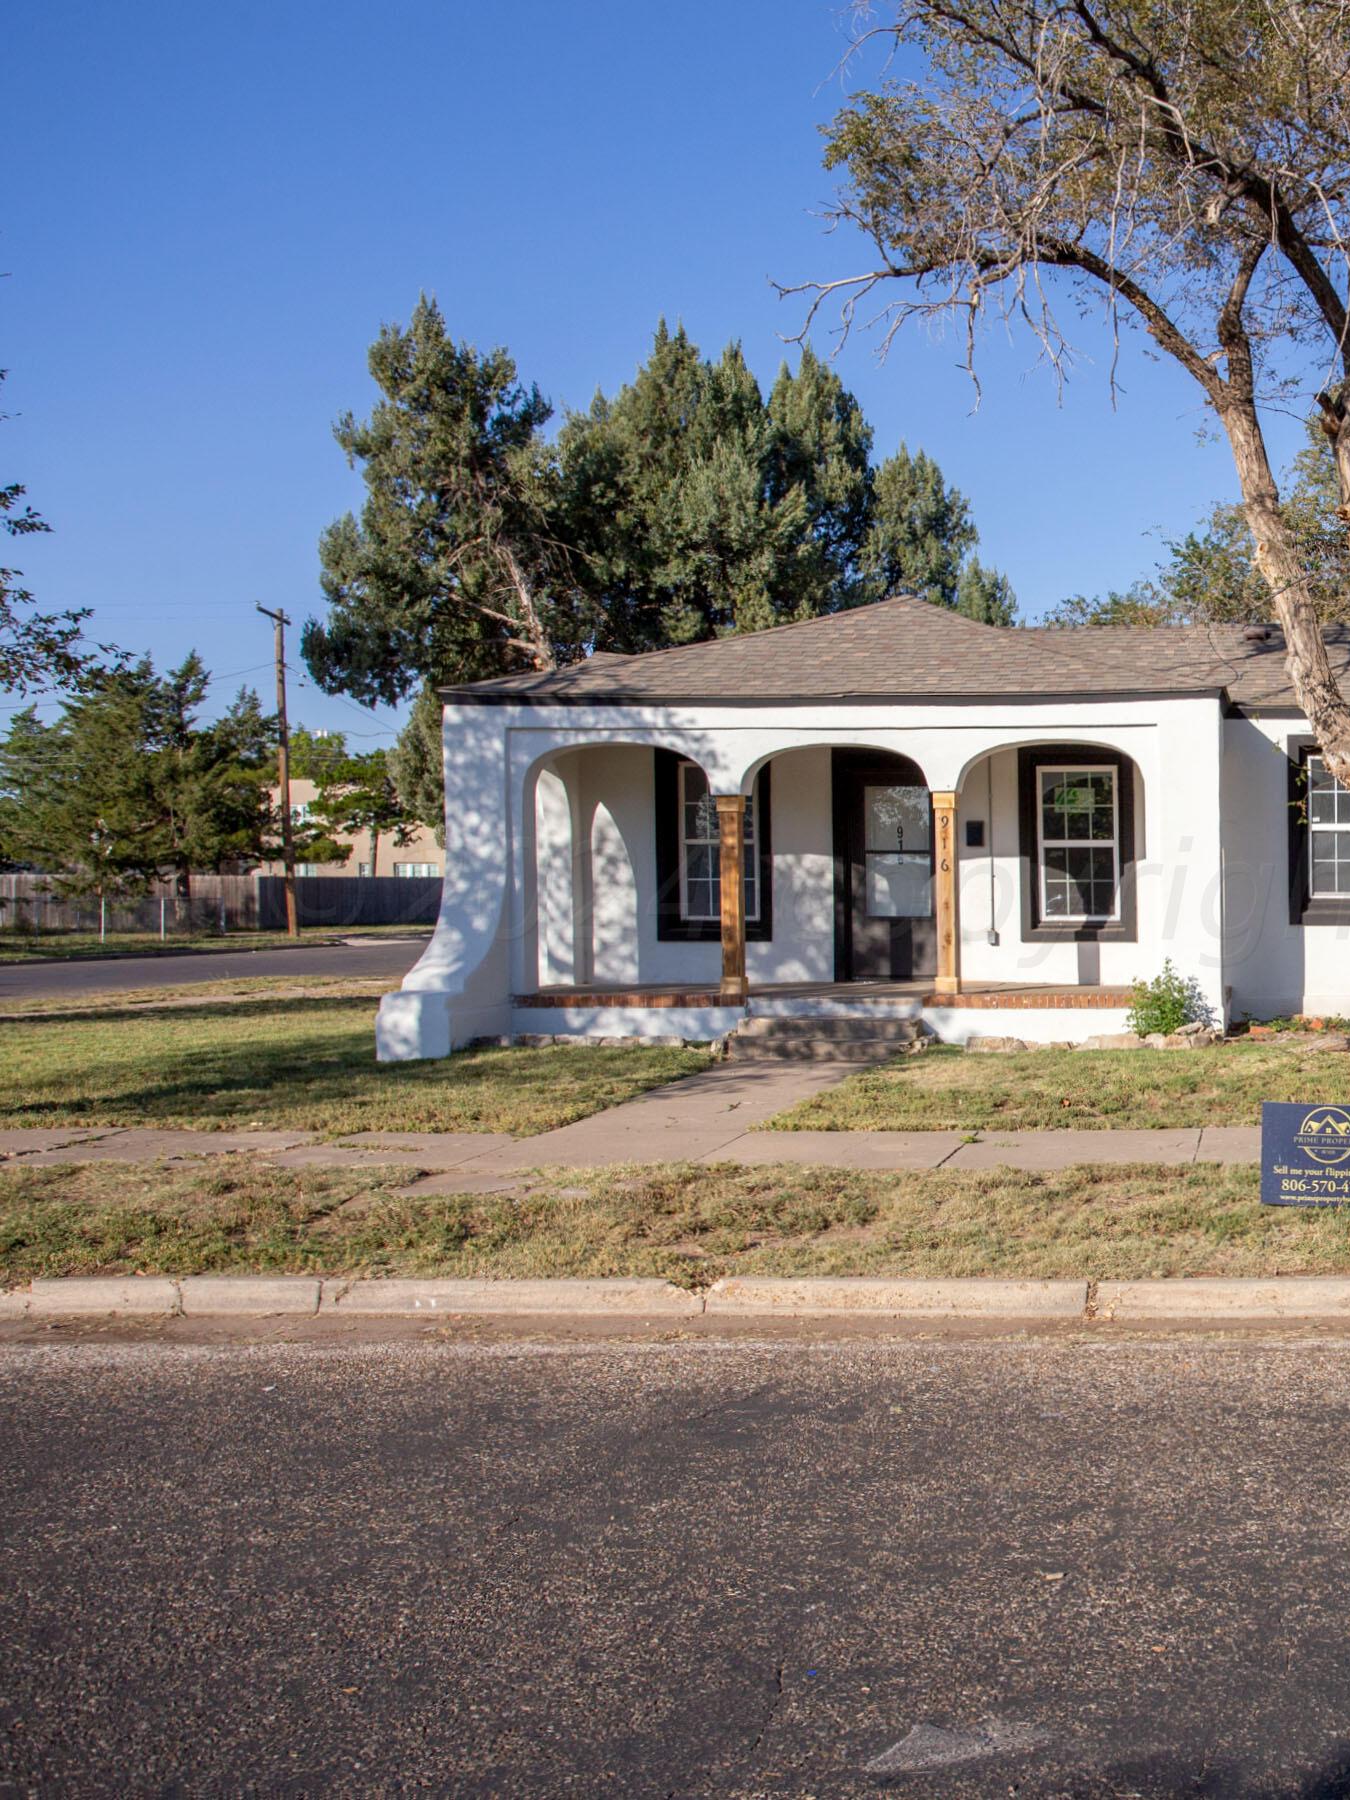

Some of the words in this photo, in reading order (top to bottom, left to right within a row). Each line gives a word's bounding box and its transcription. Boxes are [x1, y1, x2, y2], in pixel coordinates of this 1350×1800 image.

[940, 815, 950, 872] 916
[1273, 1165, 1288, 1174] Sell
[1290, 1167, 1303, 1175] me
[1304, 1168, 1323, 1179] your
